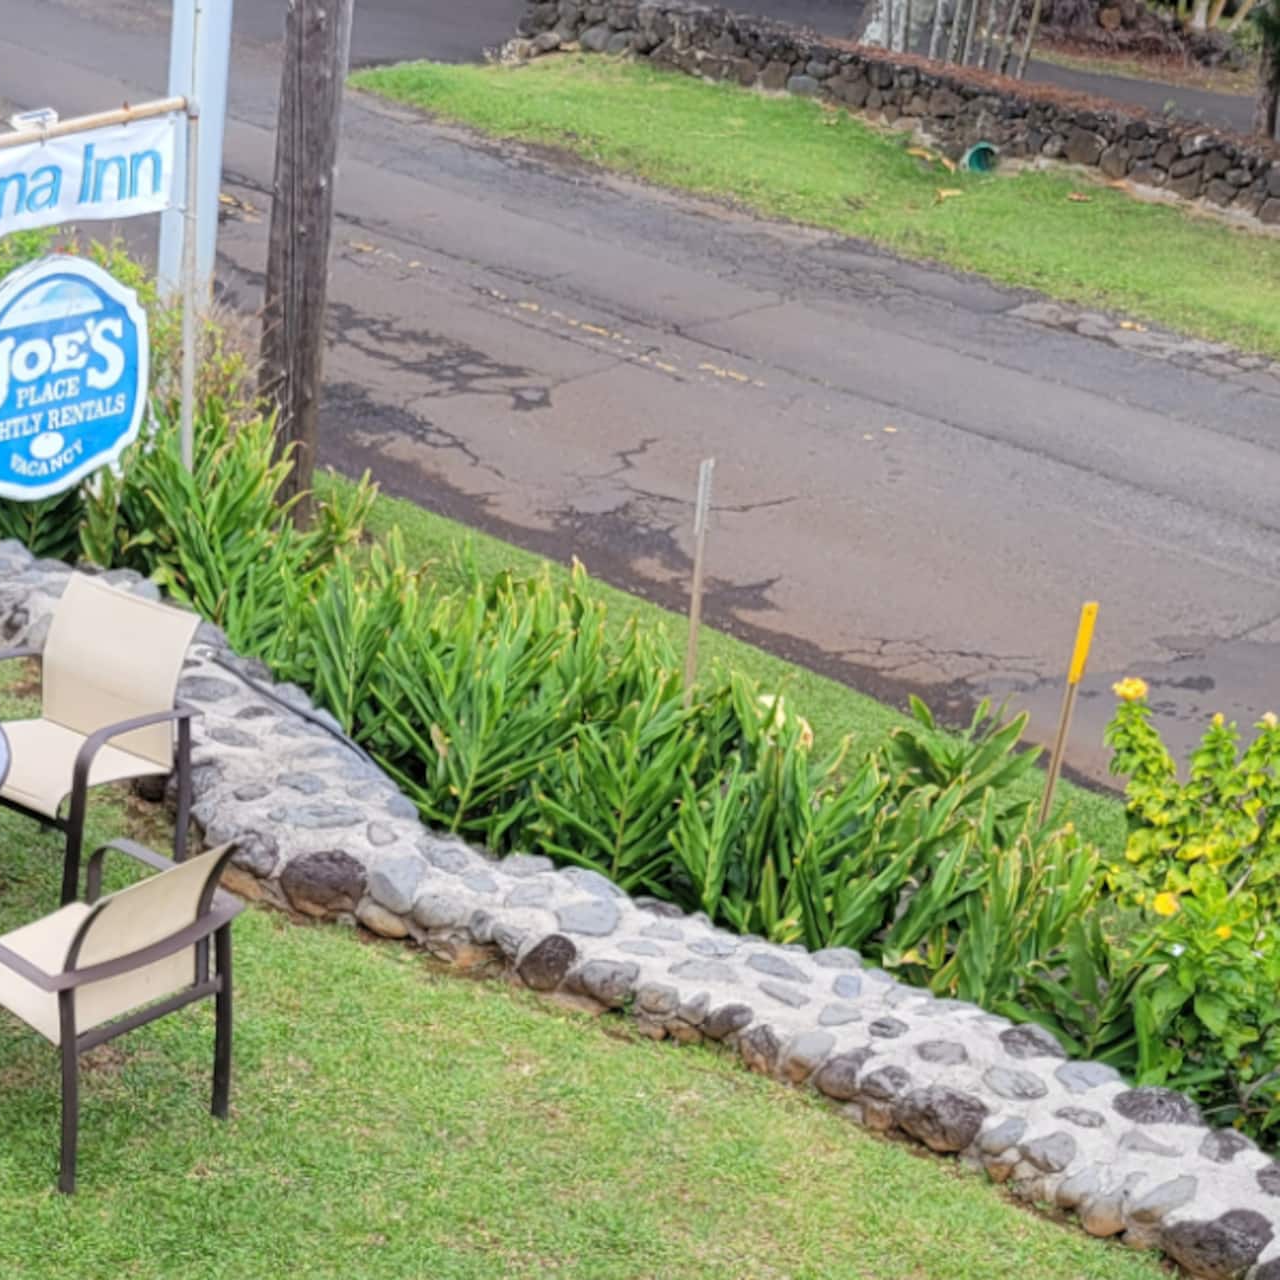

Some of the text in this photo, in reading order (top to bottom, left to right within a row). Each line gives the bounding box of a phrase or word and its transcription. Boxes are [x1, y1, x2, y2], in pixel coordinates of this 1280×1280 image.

[78, 142, 162, 204] Inn
[16, 375, 81, 409] PLACE
[48, 393, 126, 431] RENTALS
[10, 439, 83, 477] VACANCY
